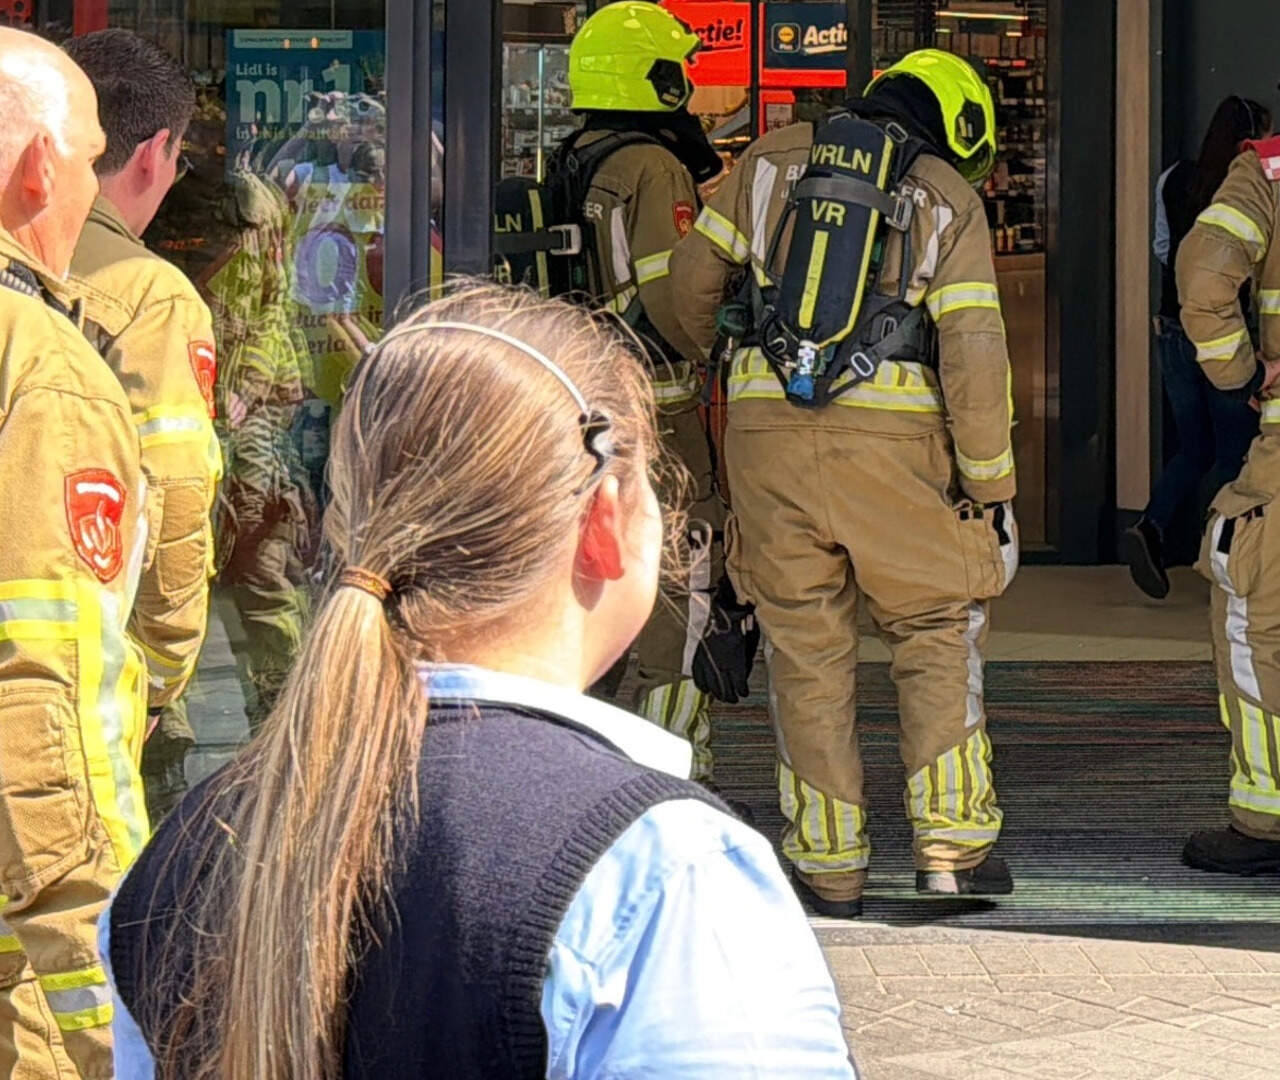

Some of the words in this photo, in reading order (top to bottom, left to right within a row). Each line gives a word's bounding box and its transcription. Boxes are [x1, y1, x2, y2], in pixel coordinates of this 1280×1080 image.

[686, 18, 743, 44] ctie!
[235, 62, 262, 76] Lidl
[265, 63, 277, 76] is
[810, 143, 873, 174] VRLN
[811, 199, 846, 226] VR
